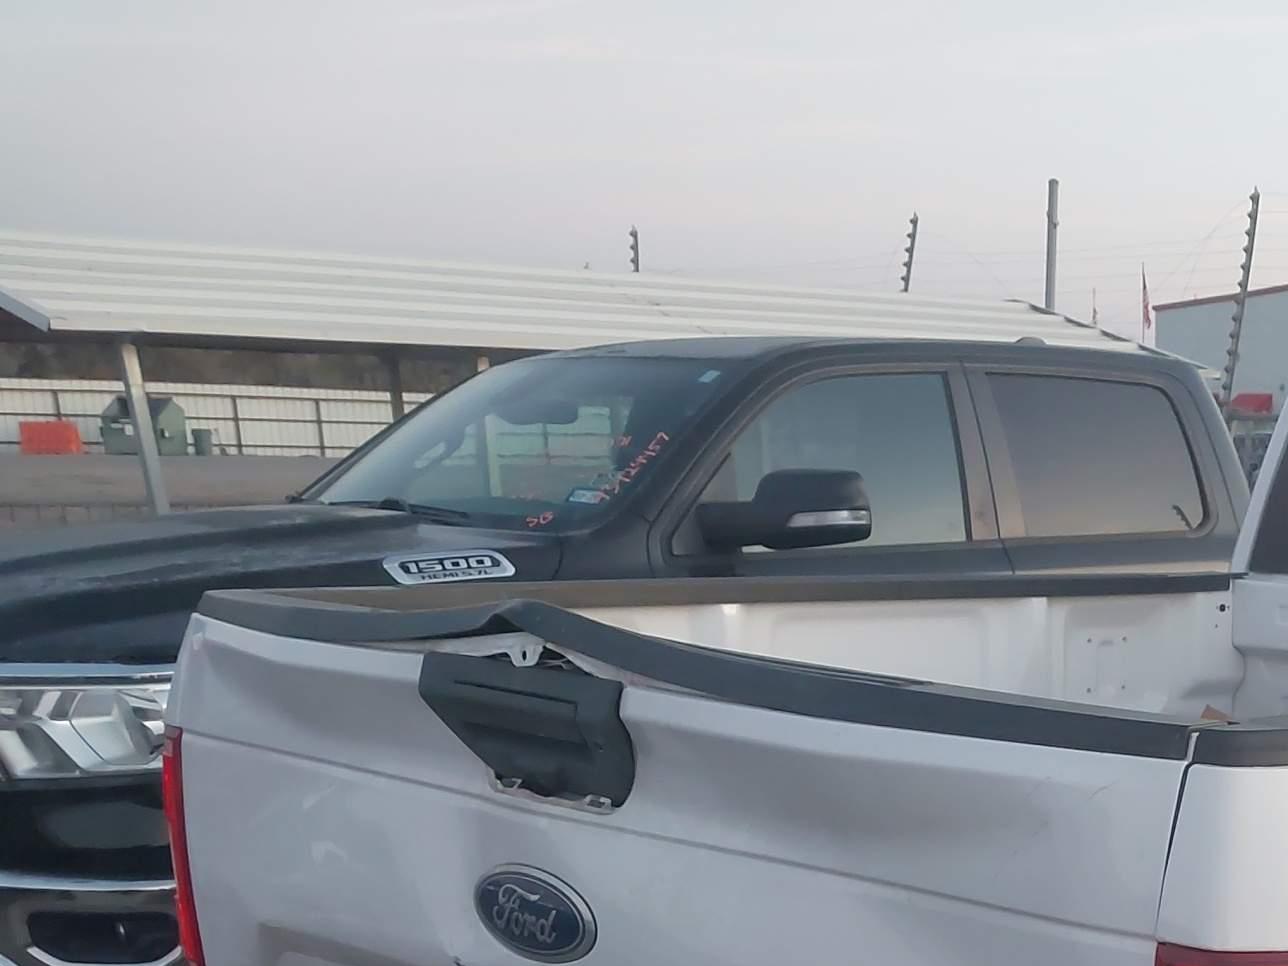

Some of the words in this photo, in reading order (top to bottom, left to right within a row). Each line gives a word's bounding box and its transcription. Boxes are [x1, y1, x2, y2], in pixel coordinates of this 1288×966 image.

[401, 556, 492, 573] 1500
[421, 571, 459, 580] HEMI
[493, 883, 557, 943] Ford
